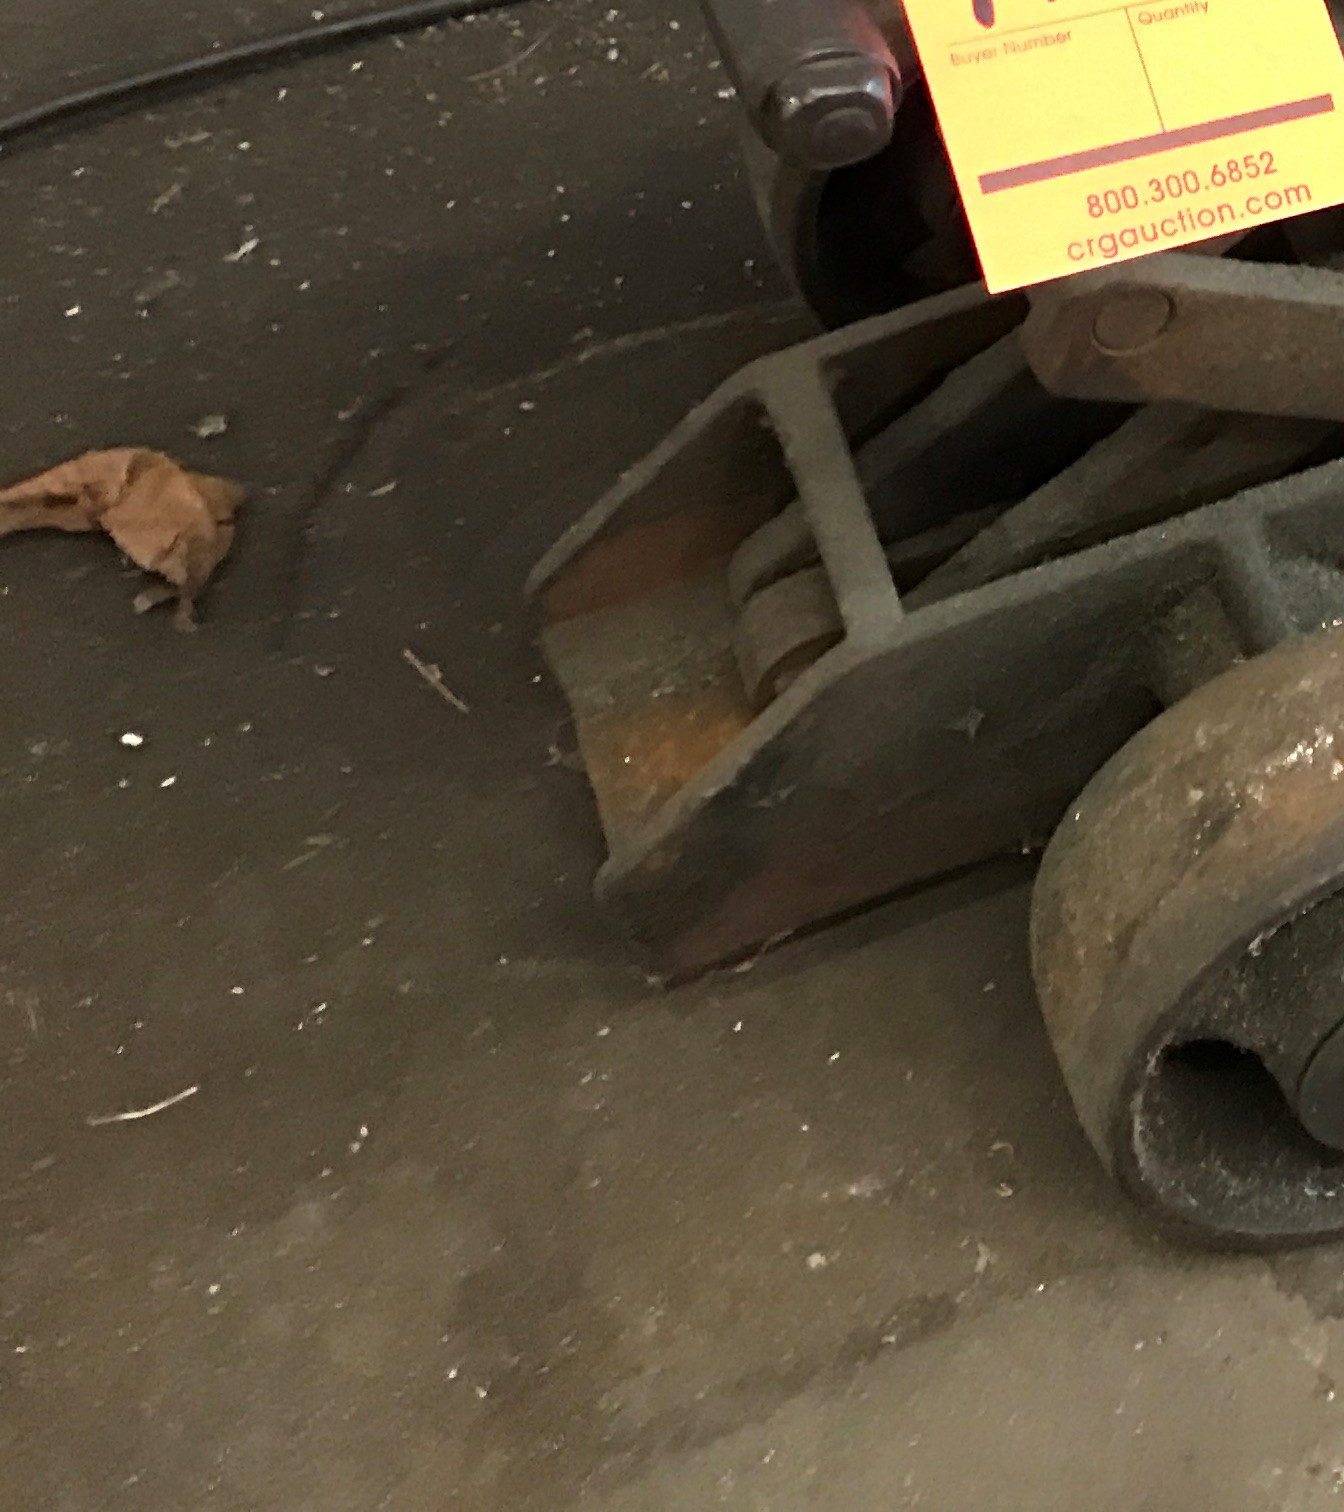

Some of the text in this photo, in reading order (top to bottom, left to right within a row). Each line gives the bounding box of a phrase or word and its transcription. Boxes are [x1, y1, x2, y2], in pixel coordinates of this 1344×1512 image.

[1137, 0, 1210, 26] Quantity
[949, 29, 1073, 68] Buyer Number
[1086, 150, 1279, 219] 800.300.6852
[1066, 183, 1313, 262] crgauction.com
